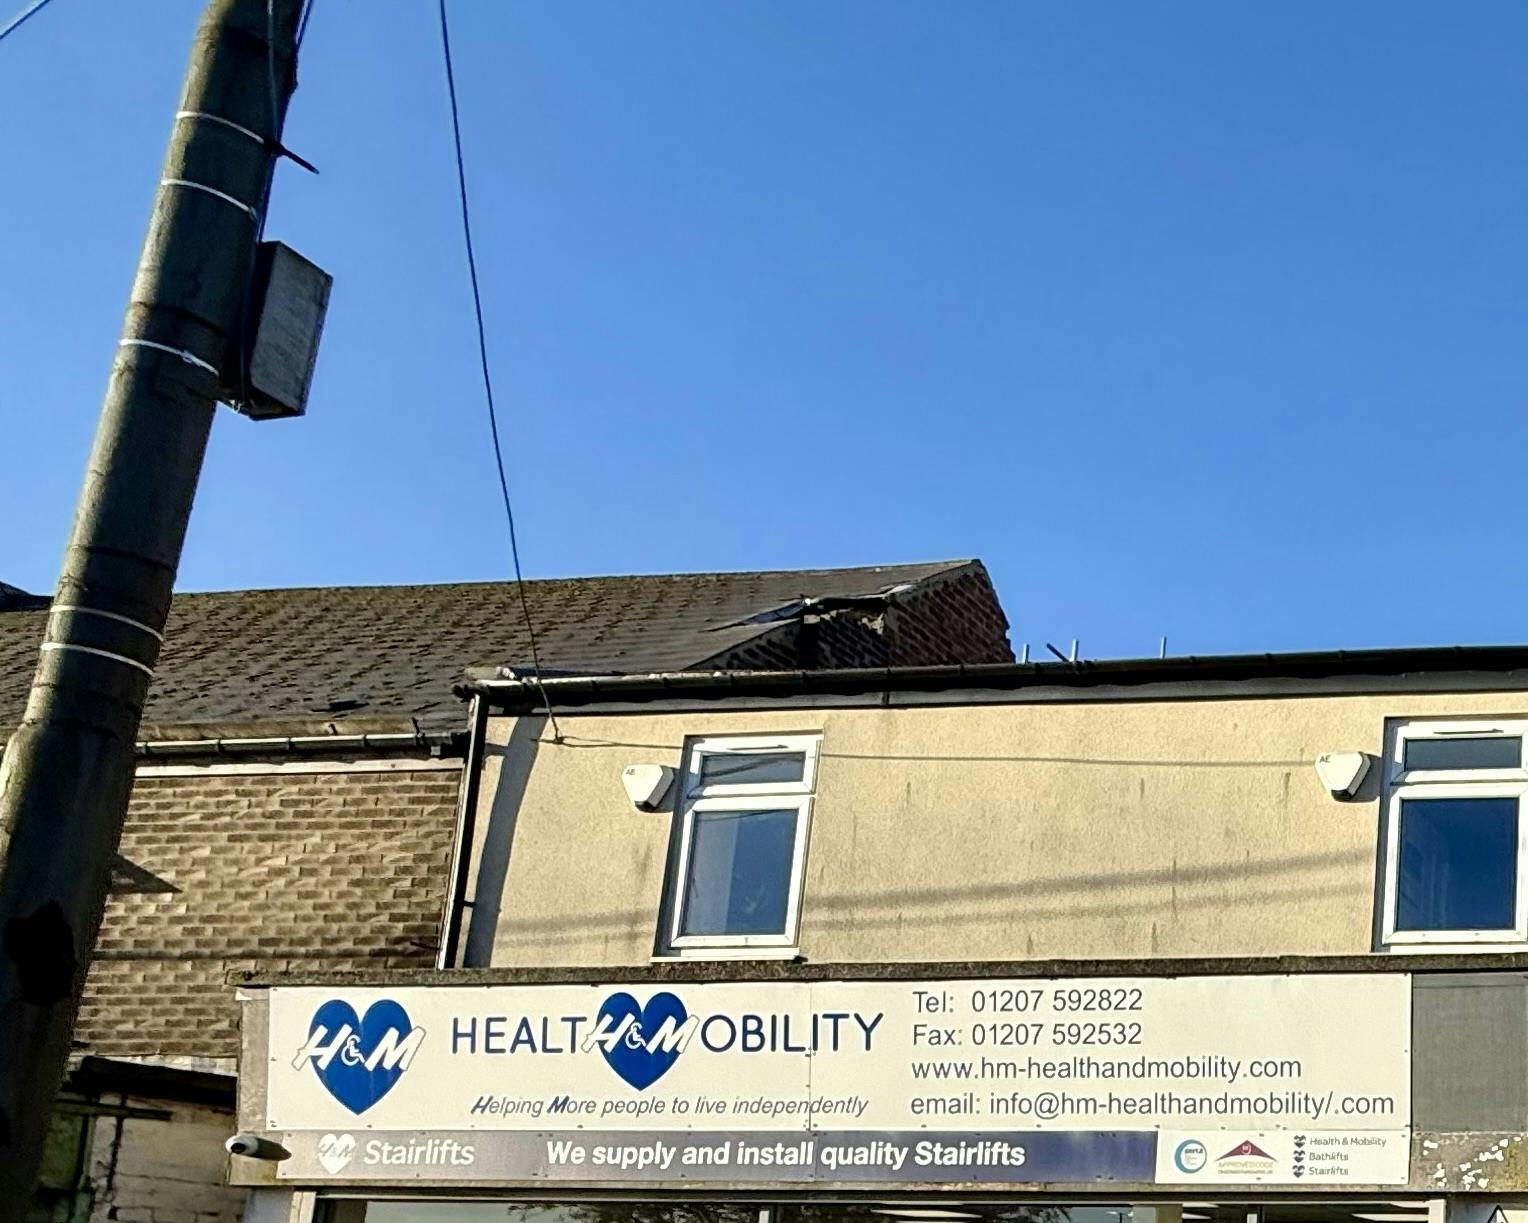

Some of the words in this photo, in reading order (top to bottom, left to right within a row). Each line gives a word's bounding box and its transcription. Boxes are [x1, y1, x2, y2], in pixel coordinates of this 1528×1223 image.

[912, 990, 955, 1013] Tel:
[971, 990, 1044, 1012] 01207
[1052, 988, 1143, 1011] 592822
[912, 1023, 963, 1046] Fax:
[971, 1023, 1044, 1045] 01207
[1052, 1022, 1142, 1045] 592532
[911, 1055, 1302, 1083] www.hm-healthandmobility.com
[470, 1095, 544, 1118] Helping
[546, 1095, 597, 1115] More
[600, 1095, 666, 1118] people
[671, 1096, 690, 1114] to
[695, 1095, 727, 1114] live
[732, 1095, 869, 1118] independently
[910, 1092, 981, 1115] email:
[989, 1090, 1395, 1120] info@hm-healthandmobility/.com
[363, 1140, 475, 1166] Stairlifts
[546, 1141, 585, 1165] We
[591, 1142, 676, 1169] supply
[681, 1142, 731, 1165] and
[736, 1141, 814, 1165] install
[820, 1142, 908, 1169] quality
[914, 1140, 1026, 1166] Stairlifts
